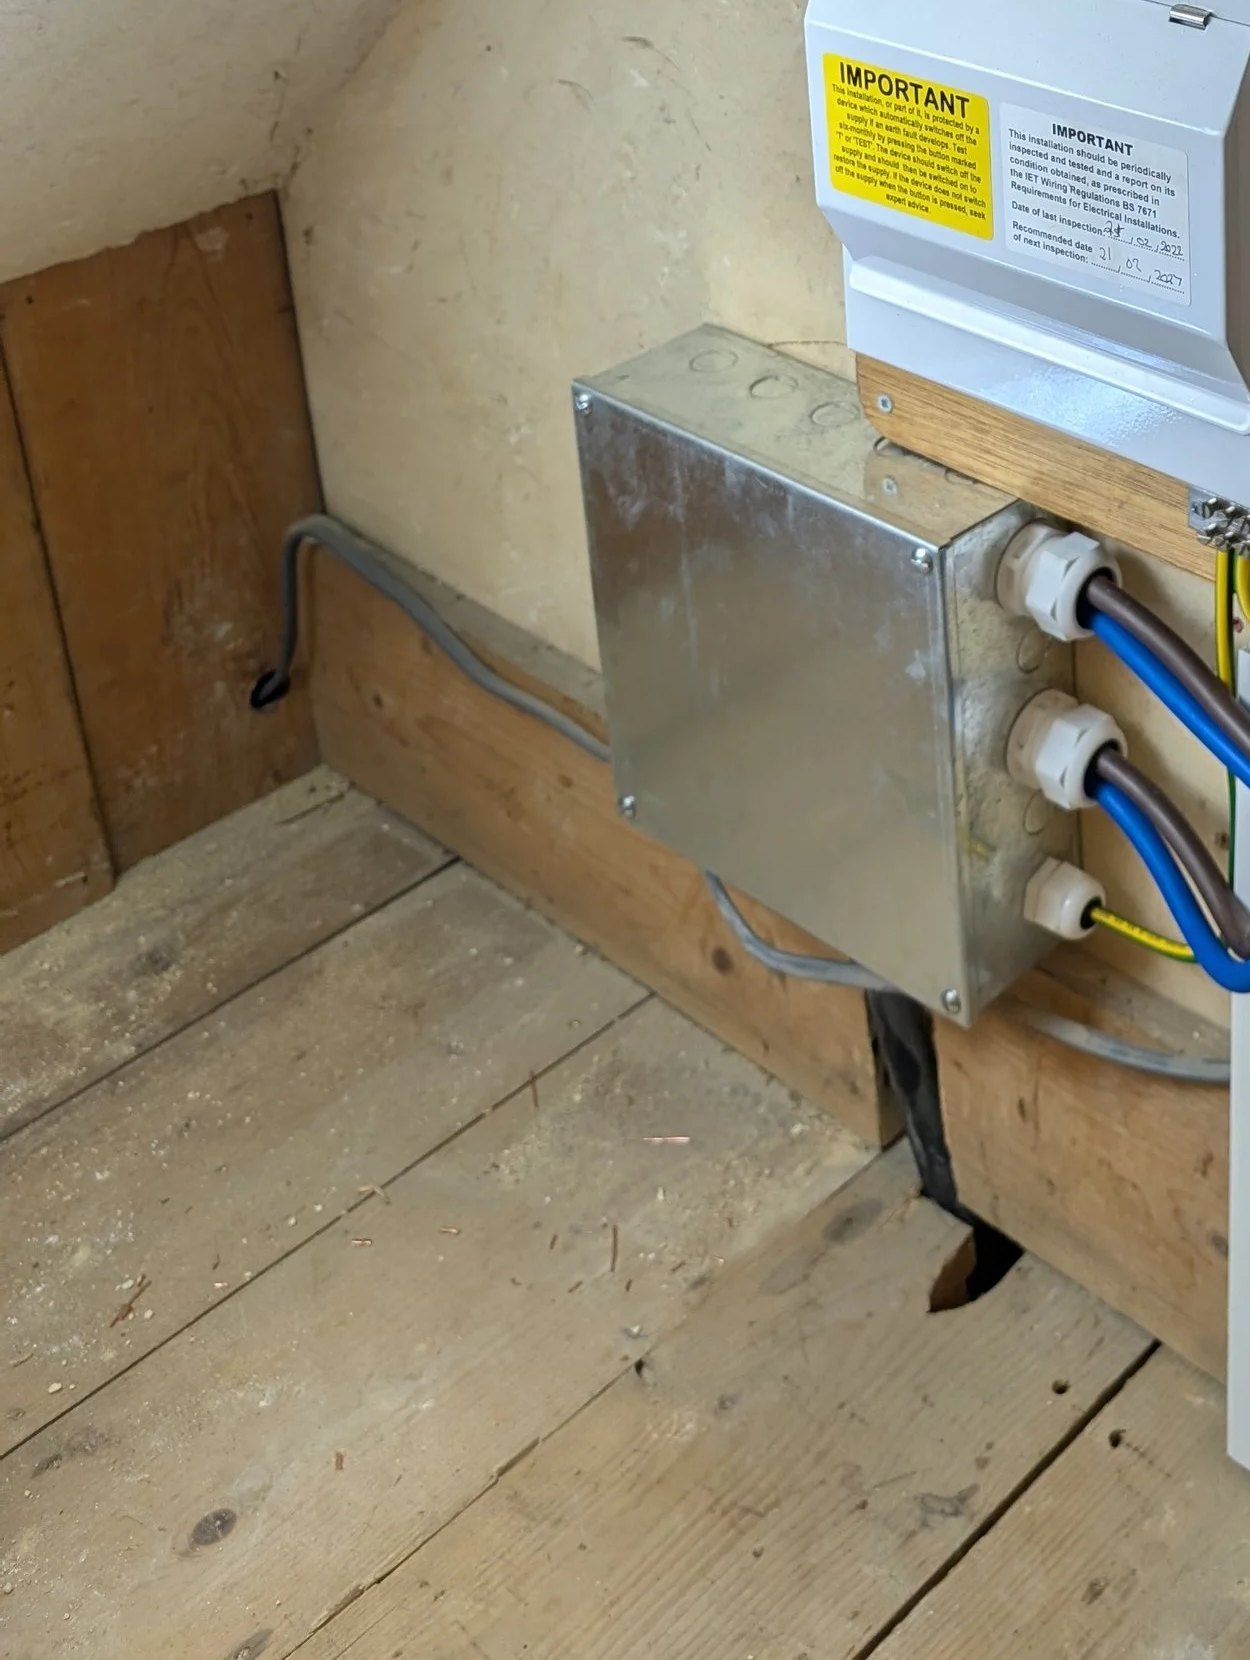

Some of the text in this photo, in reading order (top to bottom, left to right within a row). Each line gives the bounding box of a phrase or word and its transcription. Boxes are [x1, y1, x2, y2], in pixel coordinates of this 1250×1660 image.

[839, 61, 969, 118] IMPORTANT
[1008, 128, 1171, 184] This installation should be periodically
[1052, 123, 1133, 156] IMPORTANT
[1009, 140, 1175, 196] inspected and tested and a report on its
[1009, 155, 1159, 205] condition obtained, as prescribed in
[1009, 166, 1156, 217] the IET Wiring Regulations BS 7671
[1011, 180, 1180, 238] Requirements for Electrical Installations.
[1011, 199, 1030, 213] Date
[1031, 207, 1040, 217] of
[1041, 208, 1057, 222] last
[1012, 220, 1092, 253] Recommended date
[1013, 232, 1088, 263] of next inspection:
